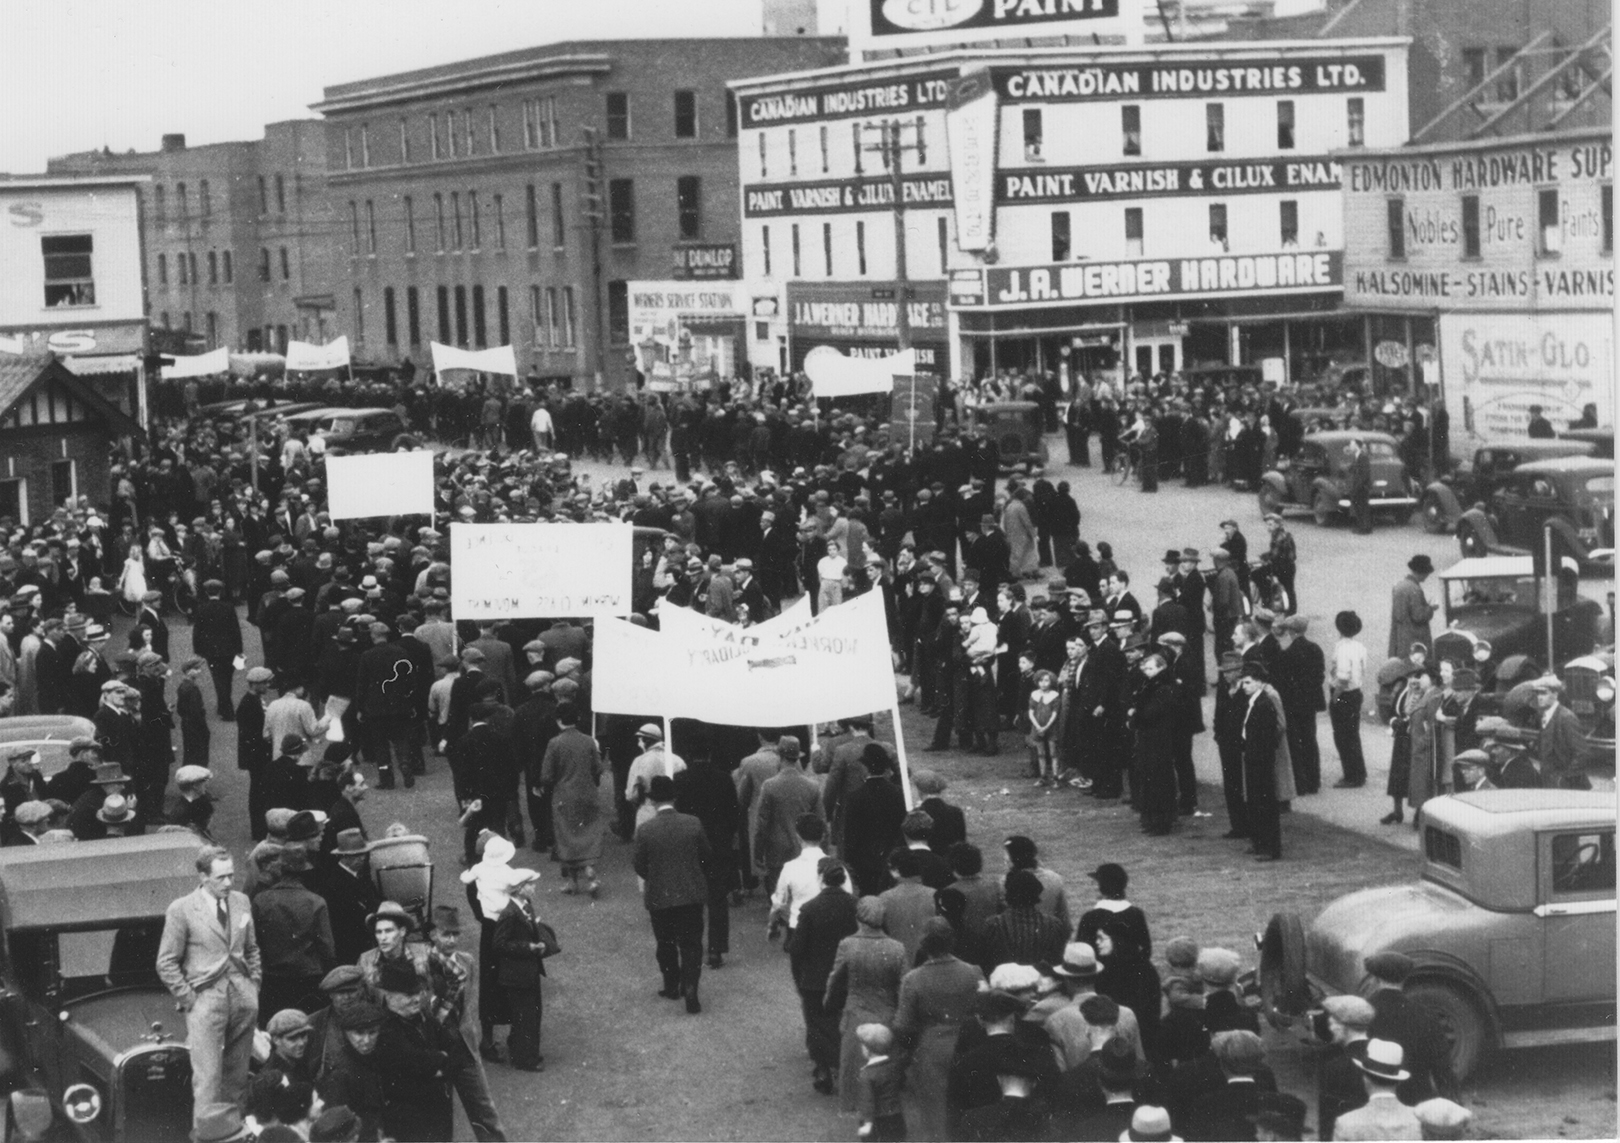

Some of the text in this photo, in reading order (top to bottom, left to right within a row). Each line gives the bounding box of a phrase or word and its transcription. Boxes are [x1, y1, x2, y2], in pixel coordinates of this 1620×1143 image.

[1007, 65, 1366, 97] CANADIAN INDUSTRIES LTD.
[750, 94, 818, 121] CANADIAN
[823, 84, 908, 114] INDUSTRIES
[1084, 169, 1180, 194] VARNISH
[1189, 169, 1204, 189] &
[1212, 165, 1276, 188] CILUX
[1351, 161, 1442, 193] EDMONTON
[1453, 149, 1559, 188] HARDWARE
[748, 190, 783, 211] PAINT
[790, 186, 840, 208] VARNISH
[1487, 204, 1525, 244] Pure
[1562, 200, 1600, 245] Paints
[1180, 253, 1331, 291] HARDWARE
[666, 292, 695, 309] SERVICE
[699, 292, 733, 309] STATION
